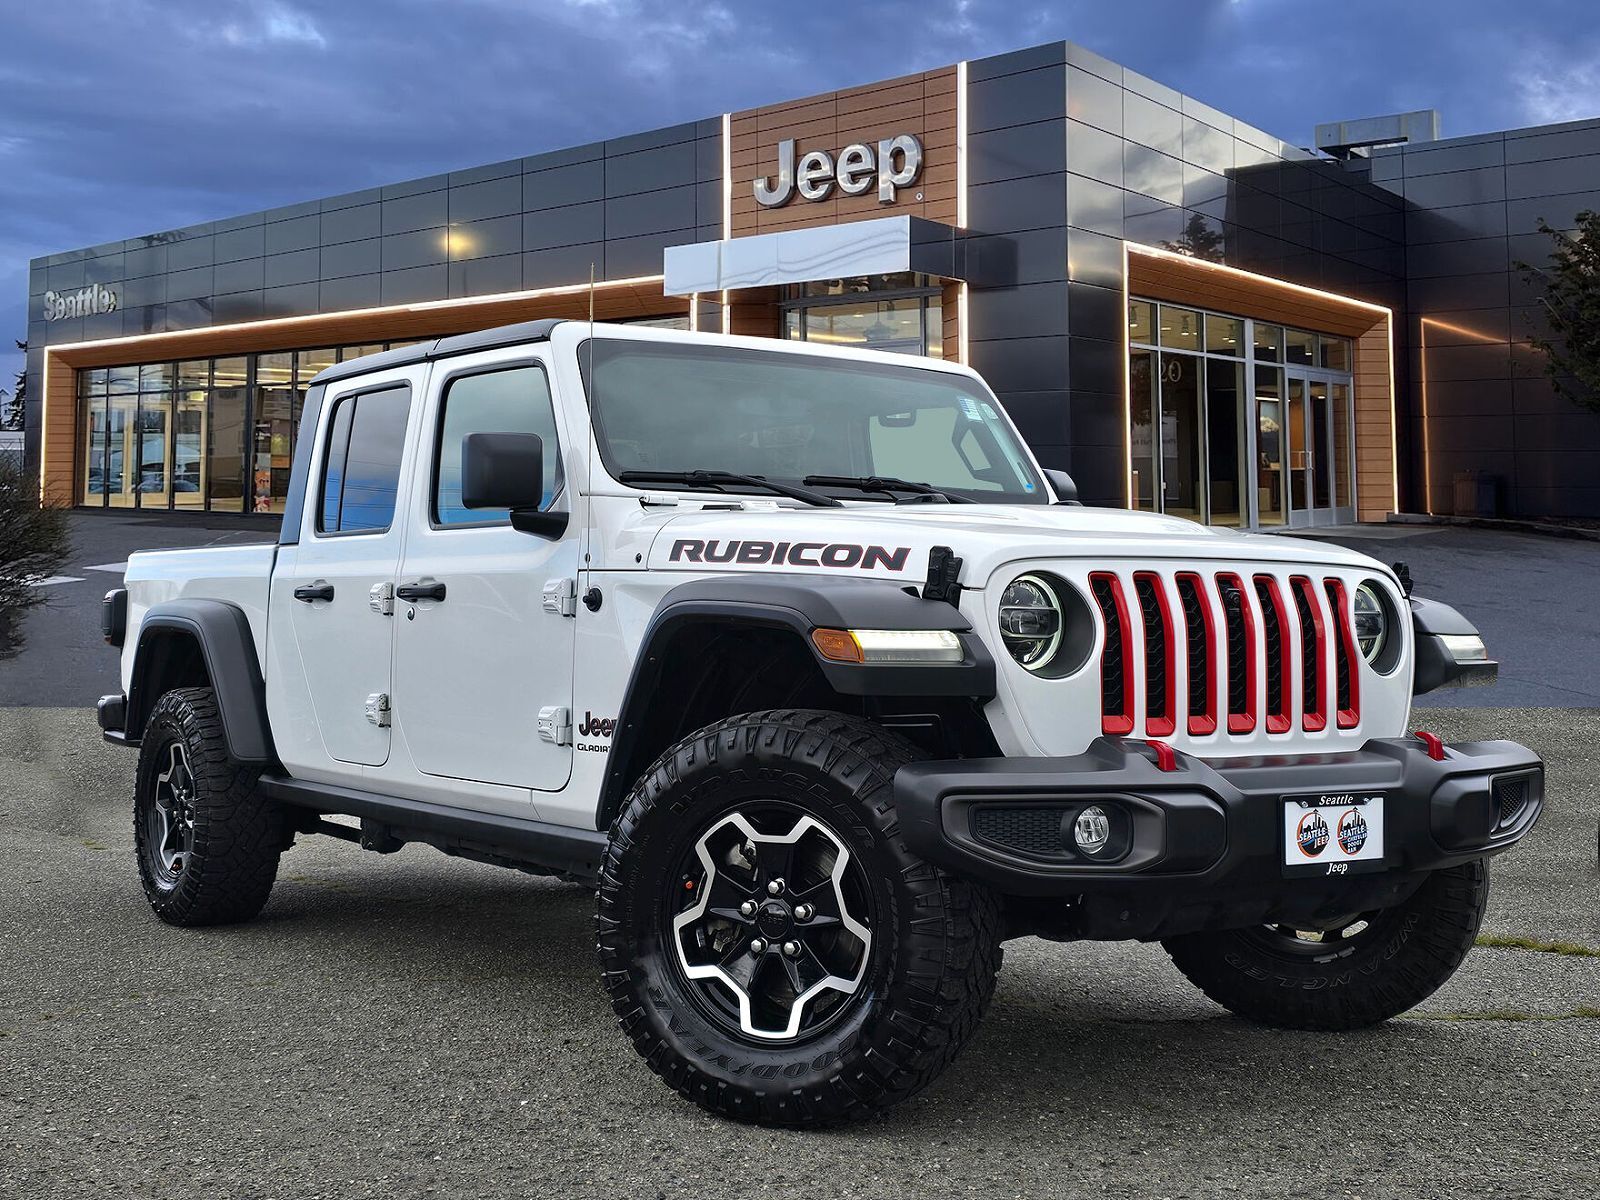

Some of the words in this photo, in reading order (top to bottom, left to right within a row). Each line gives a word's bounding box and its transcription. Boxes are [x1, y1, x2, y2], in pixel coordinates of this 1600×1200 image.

[753, 133, 924, 208] Jeep
[43, 284, 117, 321] Seattle
[668, 539, 912, 571] RUBICON
[1319, 795, 1354, 806] Seattle
[1297, 828, 1326, 842] SEATTLE
[1338, 826, 1365, 840] SEATTLE
[1314, 834, 1330, 848] JEEP
[1326, 862, 1348, 875] Jeep
